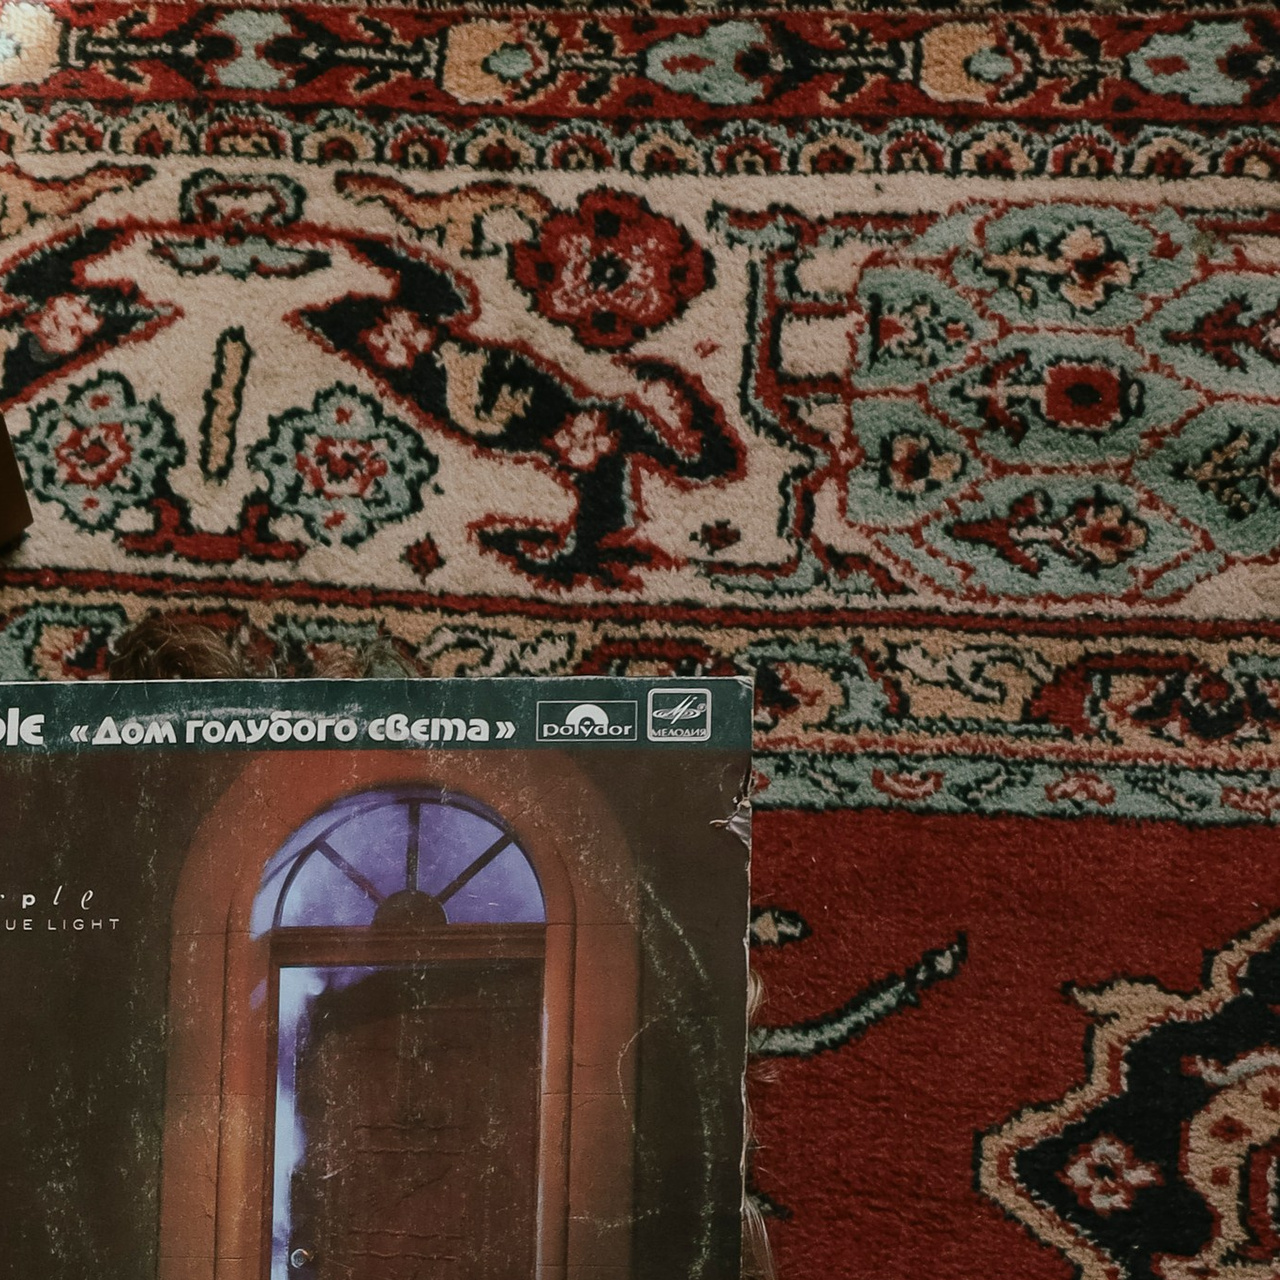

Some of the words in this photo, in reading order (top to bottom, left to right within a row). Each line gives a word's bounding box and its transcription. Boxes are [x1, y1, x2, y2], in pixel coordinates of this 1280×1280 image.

[186, 711, 356, 744] голубого
[652, 728, 707, 737] МЕЛОДИЯ
[47, 918, 120, 930] LIGHT
